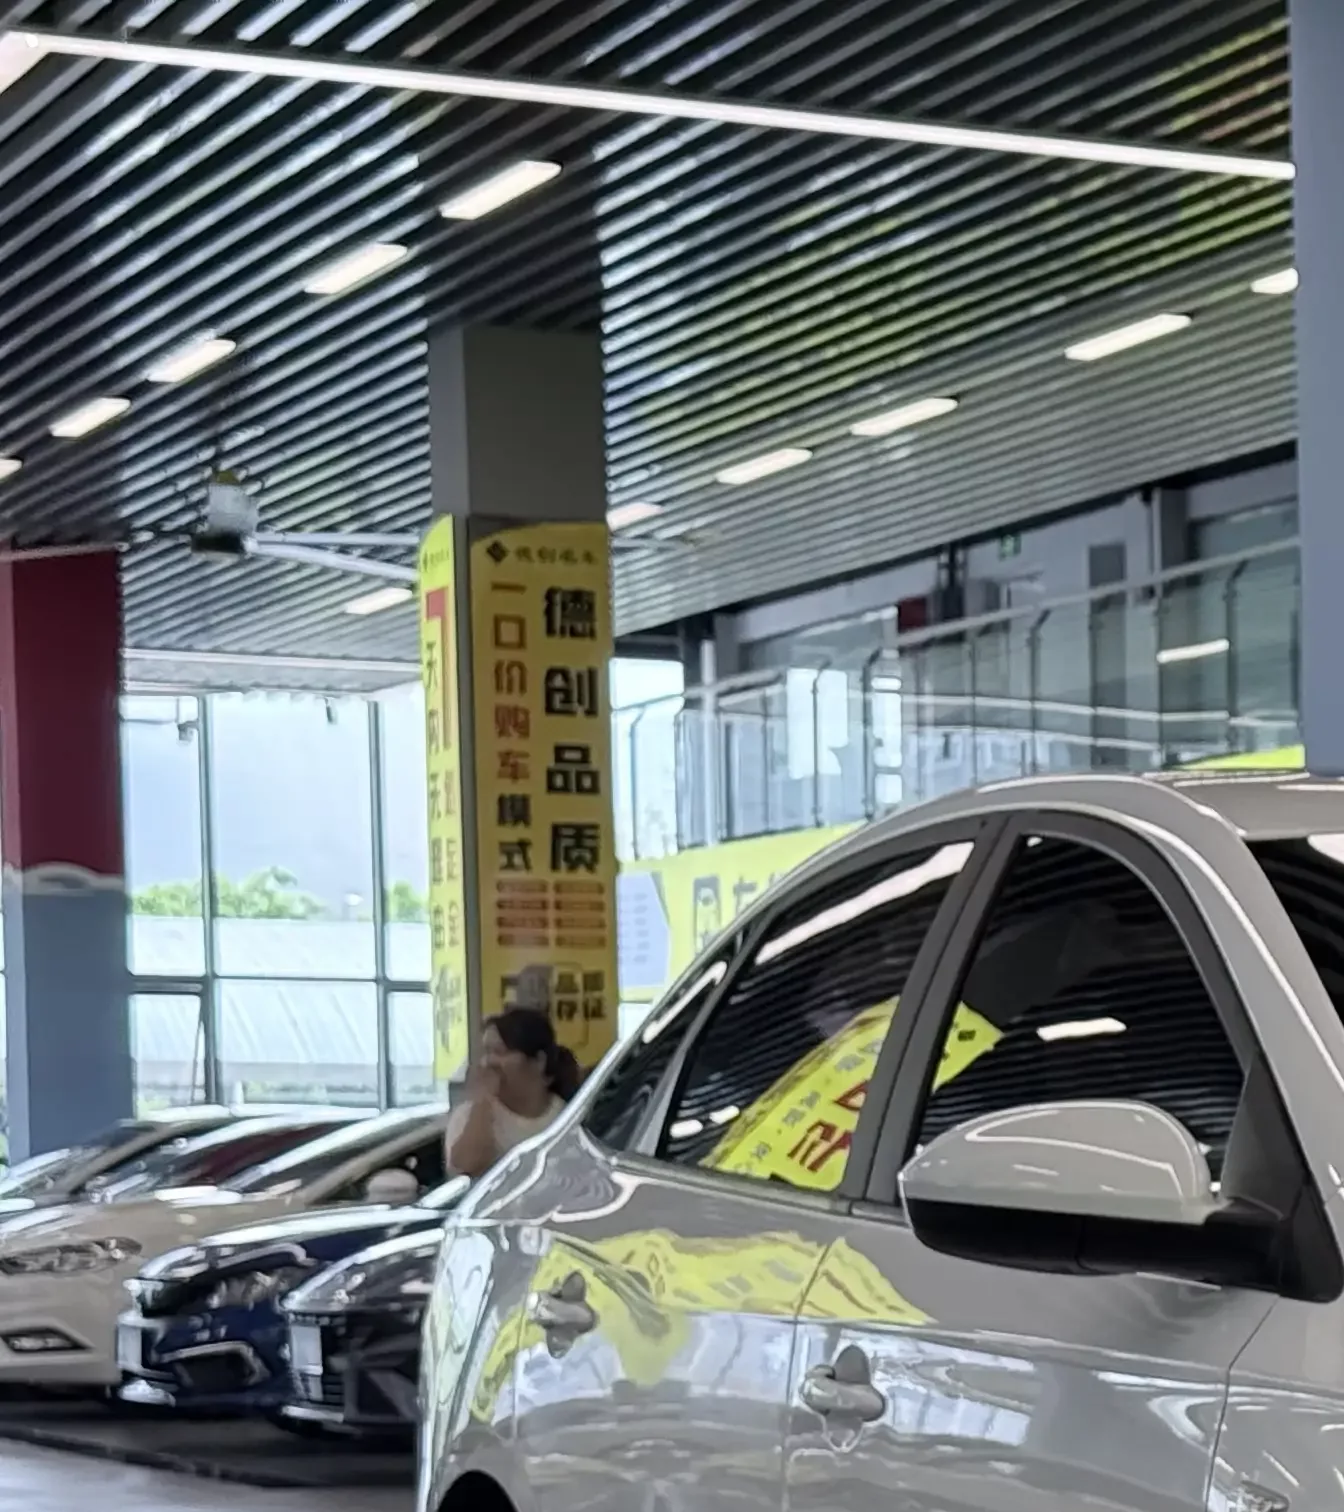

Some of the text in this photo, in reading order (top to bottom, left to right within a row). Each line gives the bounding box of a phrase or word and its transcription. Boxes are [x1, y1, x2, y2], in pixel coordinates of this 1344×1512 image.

[490, 581, 533, 872] 一口价购车模式
[544, 585, 600, 873] 德创品质
